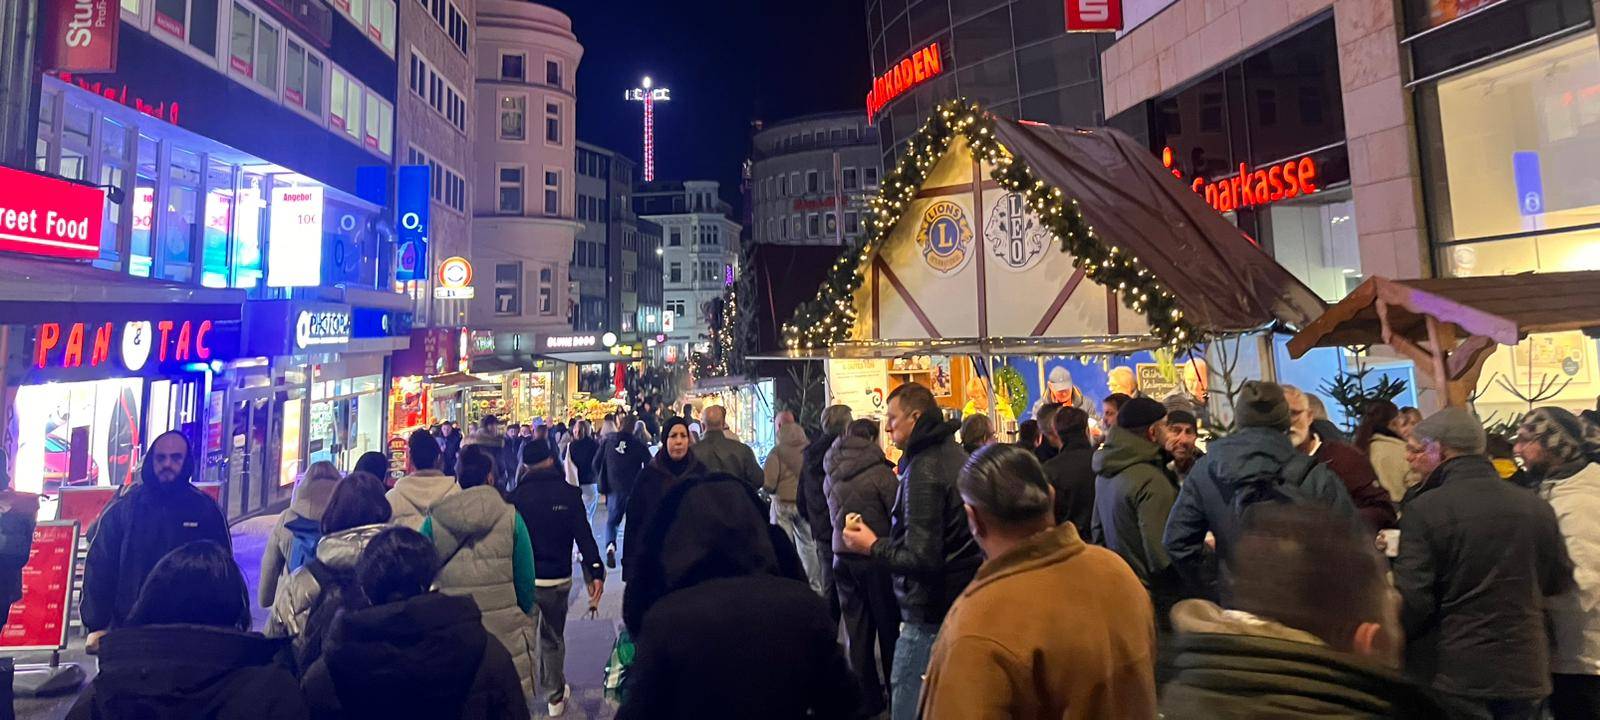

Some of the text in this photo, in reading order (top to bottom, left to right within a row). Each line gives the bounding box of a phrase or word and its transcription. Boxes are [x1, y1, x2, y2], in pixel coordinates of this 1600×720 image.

[66, 0, 93, 47] Stu
[283, 192, 312, 202] Angebot
[927, 203, 960, 220] LIONS
[46, 211, 88, 240] Food
[938, 223, 953, 248] L
[1009, 196, 1023, 263] LEO
[37, 321, 112, 368] PAN
[158, 319, 212, 361] TAC
